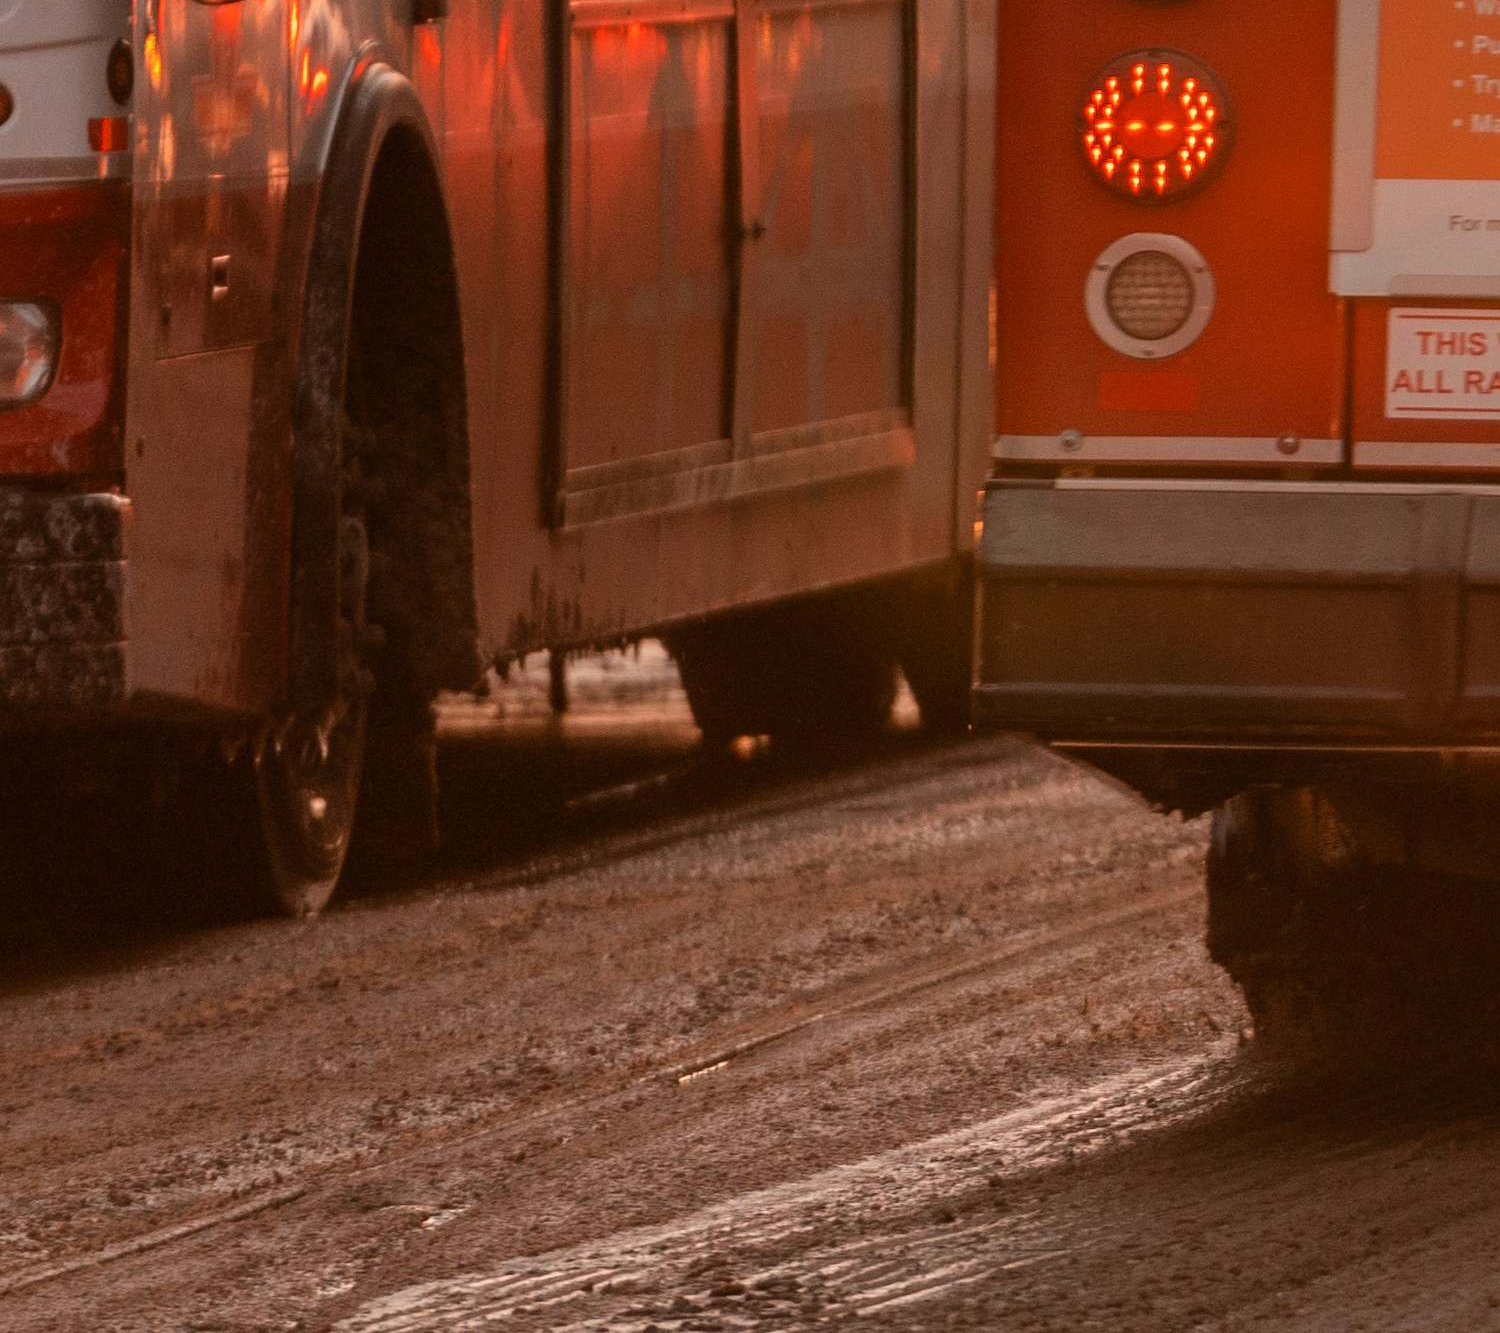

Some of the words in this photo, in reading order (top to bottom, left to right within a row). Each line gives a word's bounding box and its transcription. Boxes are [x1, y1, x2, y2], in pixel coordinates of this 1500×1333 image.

[1448, 215, 1482, 233] For
[1416, 331, 1488, 357] THIS
[1391, 369, 1453, 394] ALL
